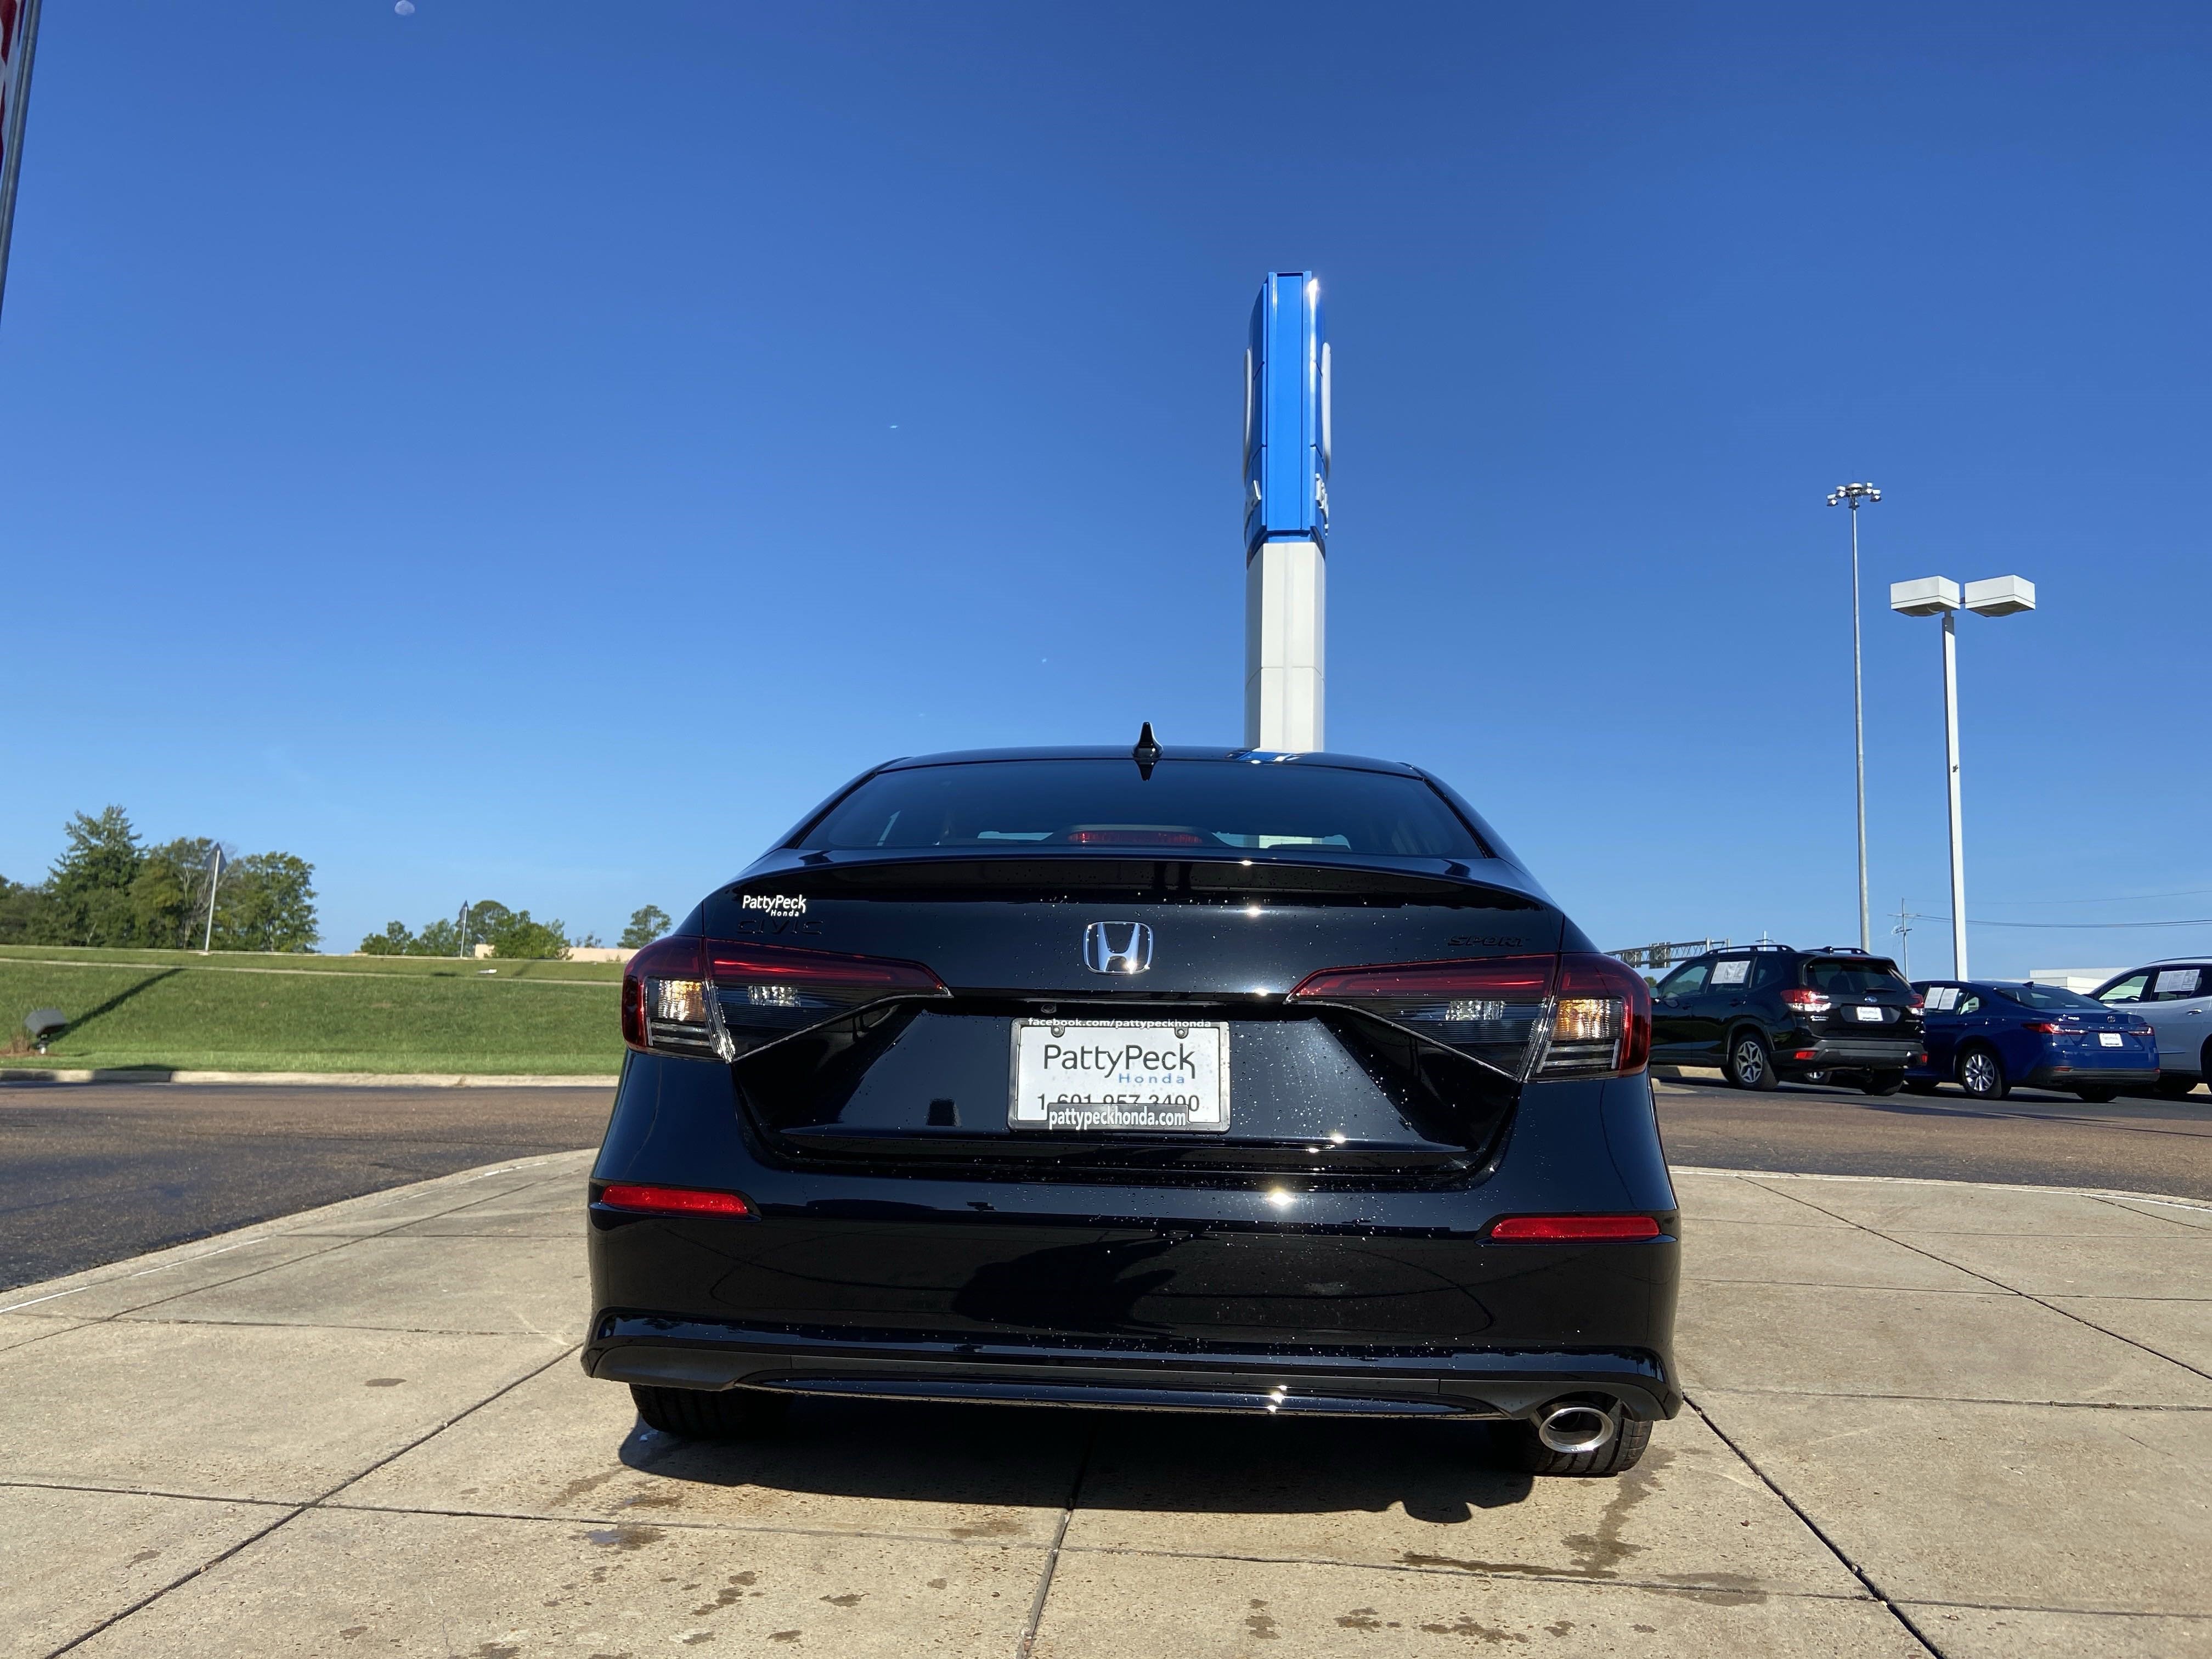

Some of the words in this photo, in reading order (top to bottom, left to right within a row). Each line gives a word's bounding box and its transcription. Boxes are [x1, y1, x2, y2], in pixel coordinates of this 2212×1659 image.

[742, 894, 806, 913] PattyPeck
[738, 919, 823, 934] CIVIC
[1448, 935, 1531, 947] SPORT
[1028, 1017, 1211, 1029] facebook.com/pattypeckhonda
[1044, 1043, 1195, 1079] PattyPeck
[1119, 1073, 1185, 1084] Honda
[1037, 1093, 1045, 1110] 1
[1049, 1105, 1186, 1130] pattypeckhonda.com
